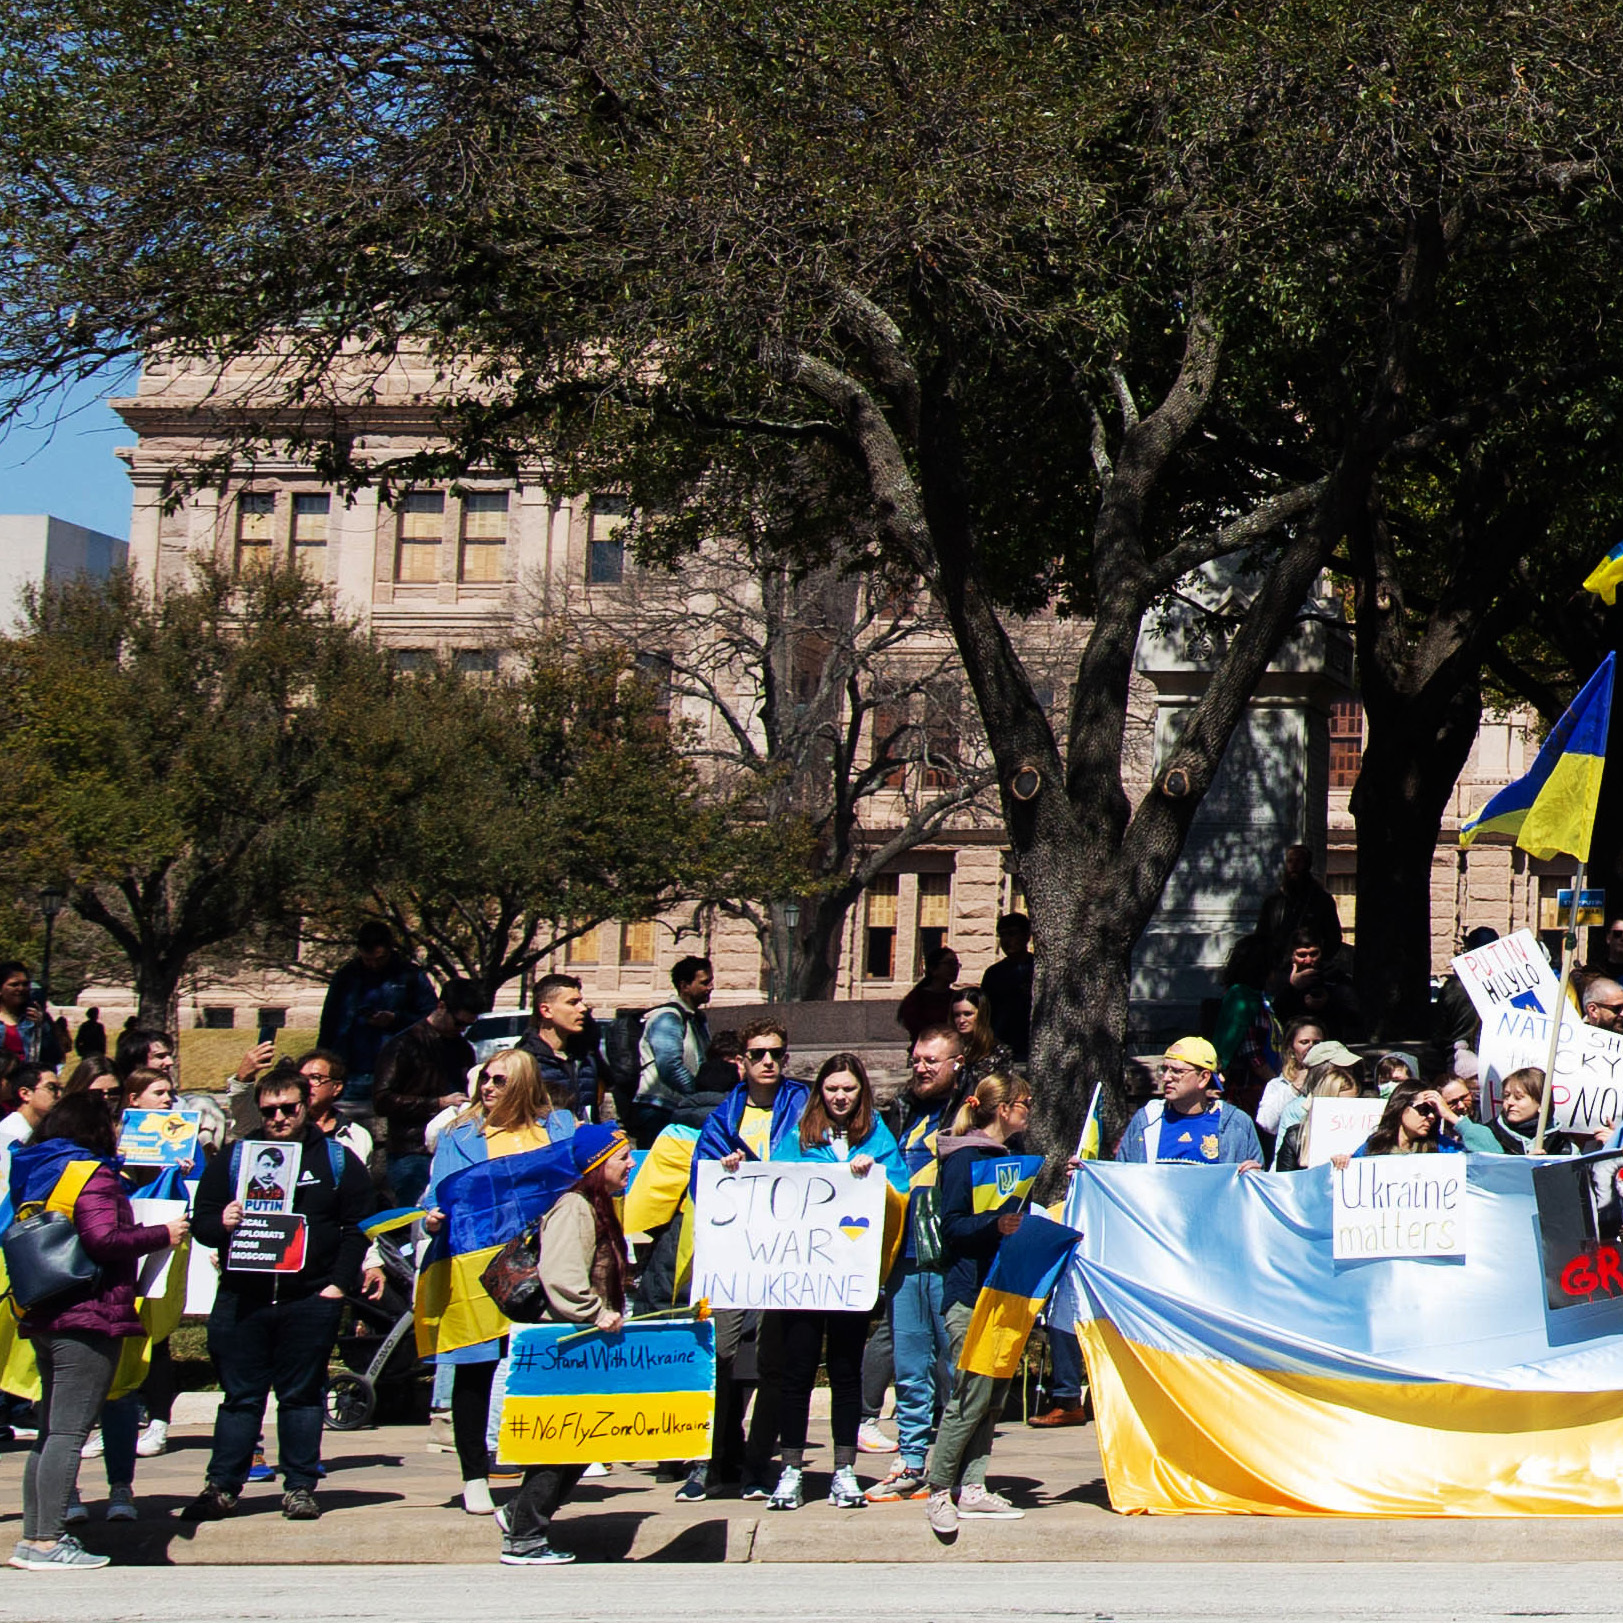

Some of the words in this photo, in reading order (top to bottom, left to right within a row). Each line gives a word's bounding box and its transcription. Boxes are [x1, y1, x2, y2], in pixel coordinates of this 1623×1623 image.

[1464, 936, 1529, 982] PUTIN
[1482, 963, 1540, 1005] HUYLO
[245, 1200, 284, 1211] PUTIN
[711, 1174, 837, 1227] STOP
[1341, 1161, 1459, 1210] Ukraine
[233, 1240, 260, 1249] FROM
[745, 1228, 835, 1265] WAR
[1338, 1211, 1457, 1253] matters
[231, 1251, 277, 1261] MOSCOW!
[702, 1271, 737, 1304] IN
[746, 1270, 865, 1308] UKRAINE
